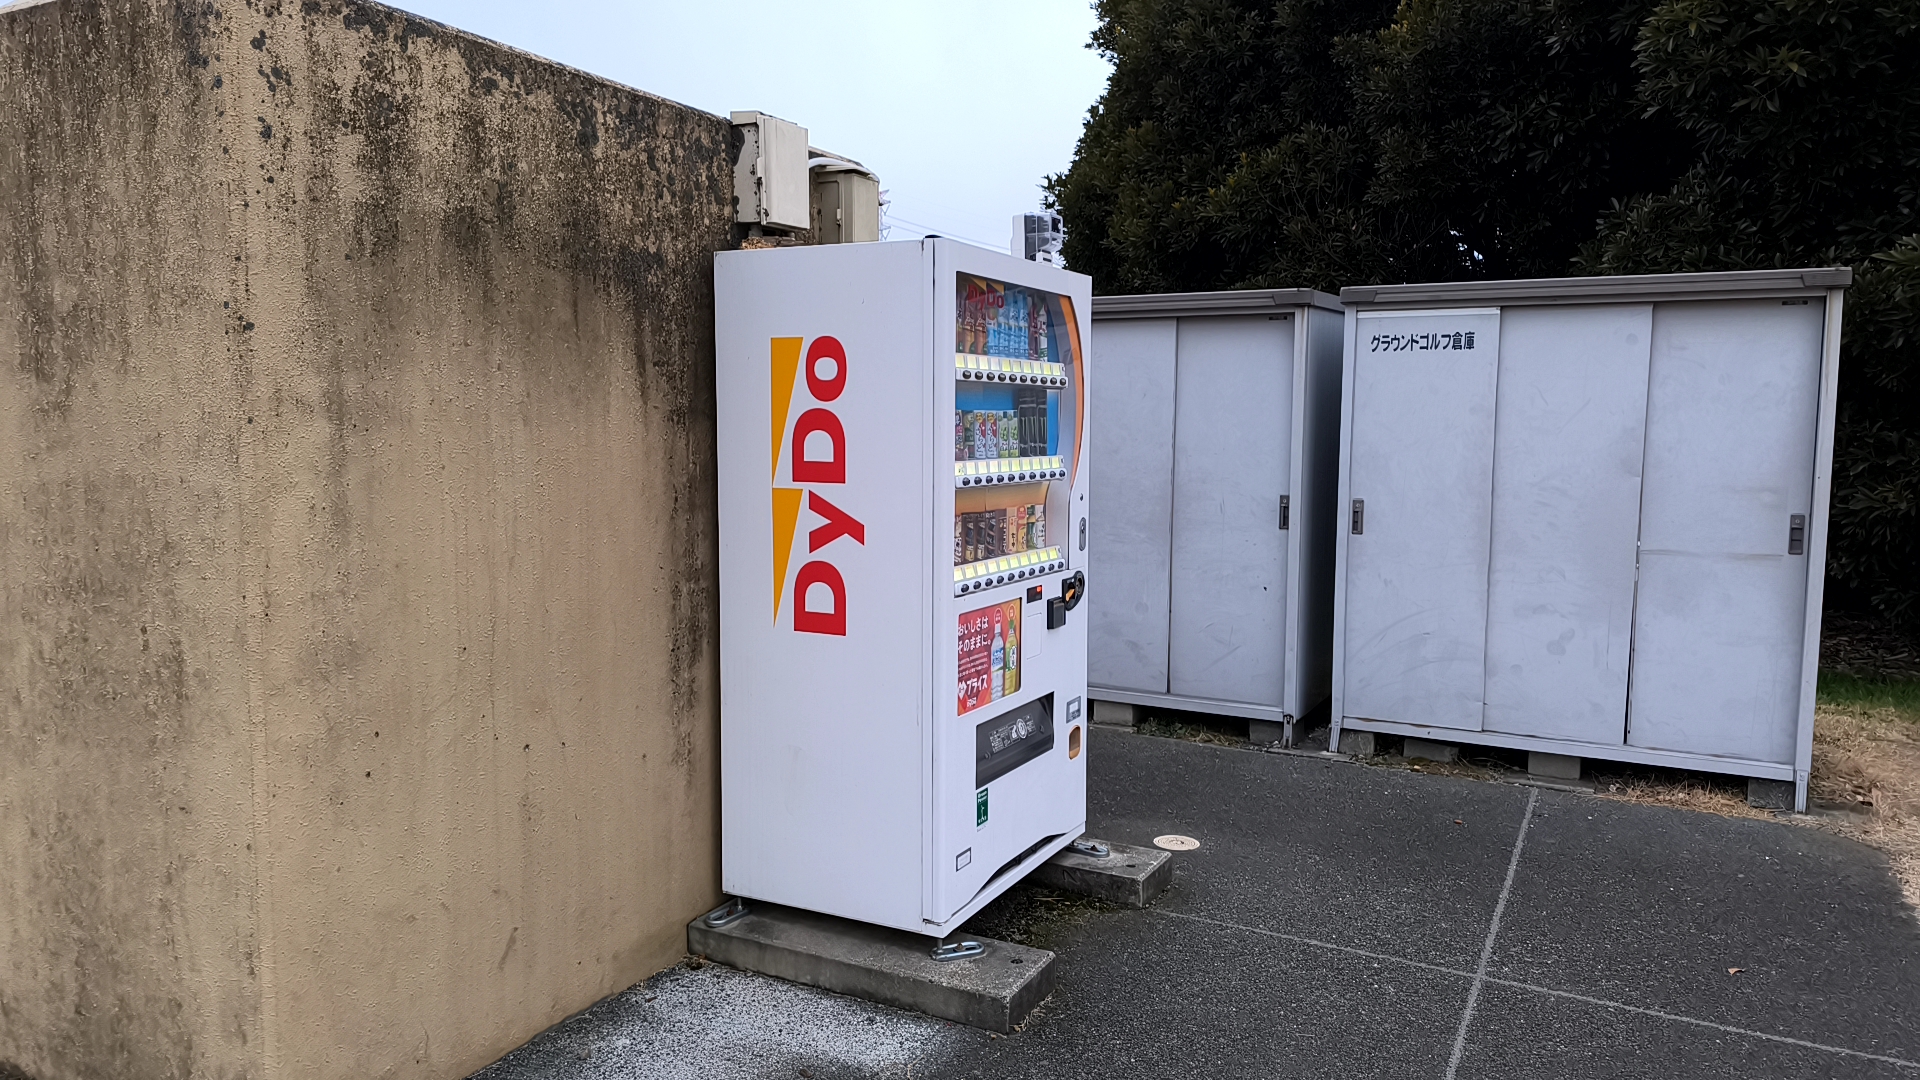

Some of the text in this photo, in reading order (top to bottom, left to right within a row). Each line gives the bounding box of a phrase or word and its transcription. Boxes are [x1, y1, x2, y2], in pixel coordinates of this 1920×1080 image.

[968, 284, 1005, 311] DyDo
[1371, 331, 1475, 353] グラウンドゴルフ倉庫
[792, 335, 865, 636] DyDo
[958, 616, 988, 636] おいしさは
[958, 634, 991, 654] そのままに。
